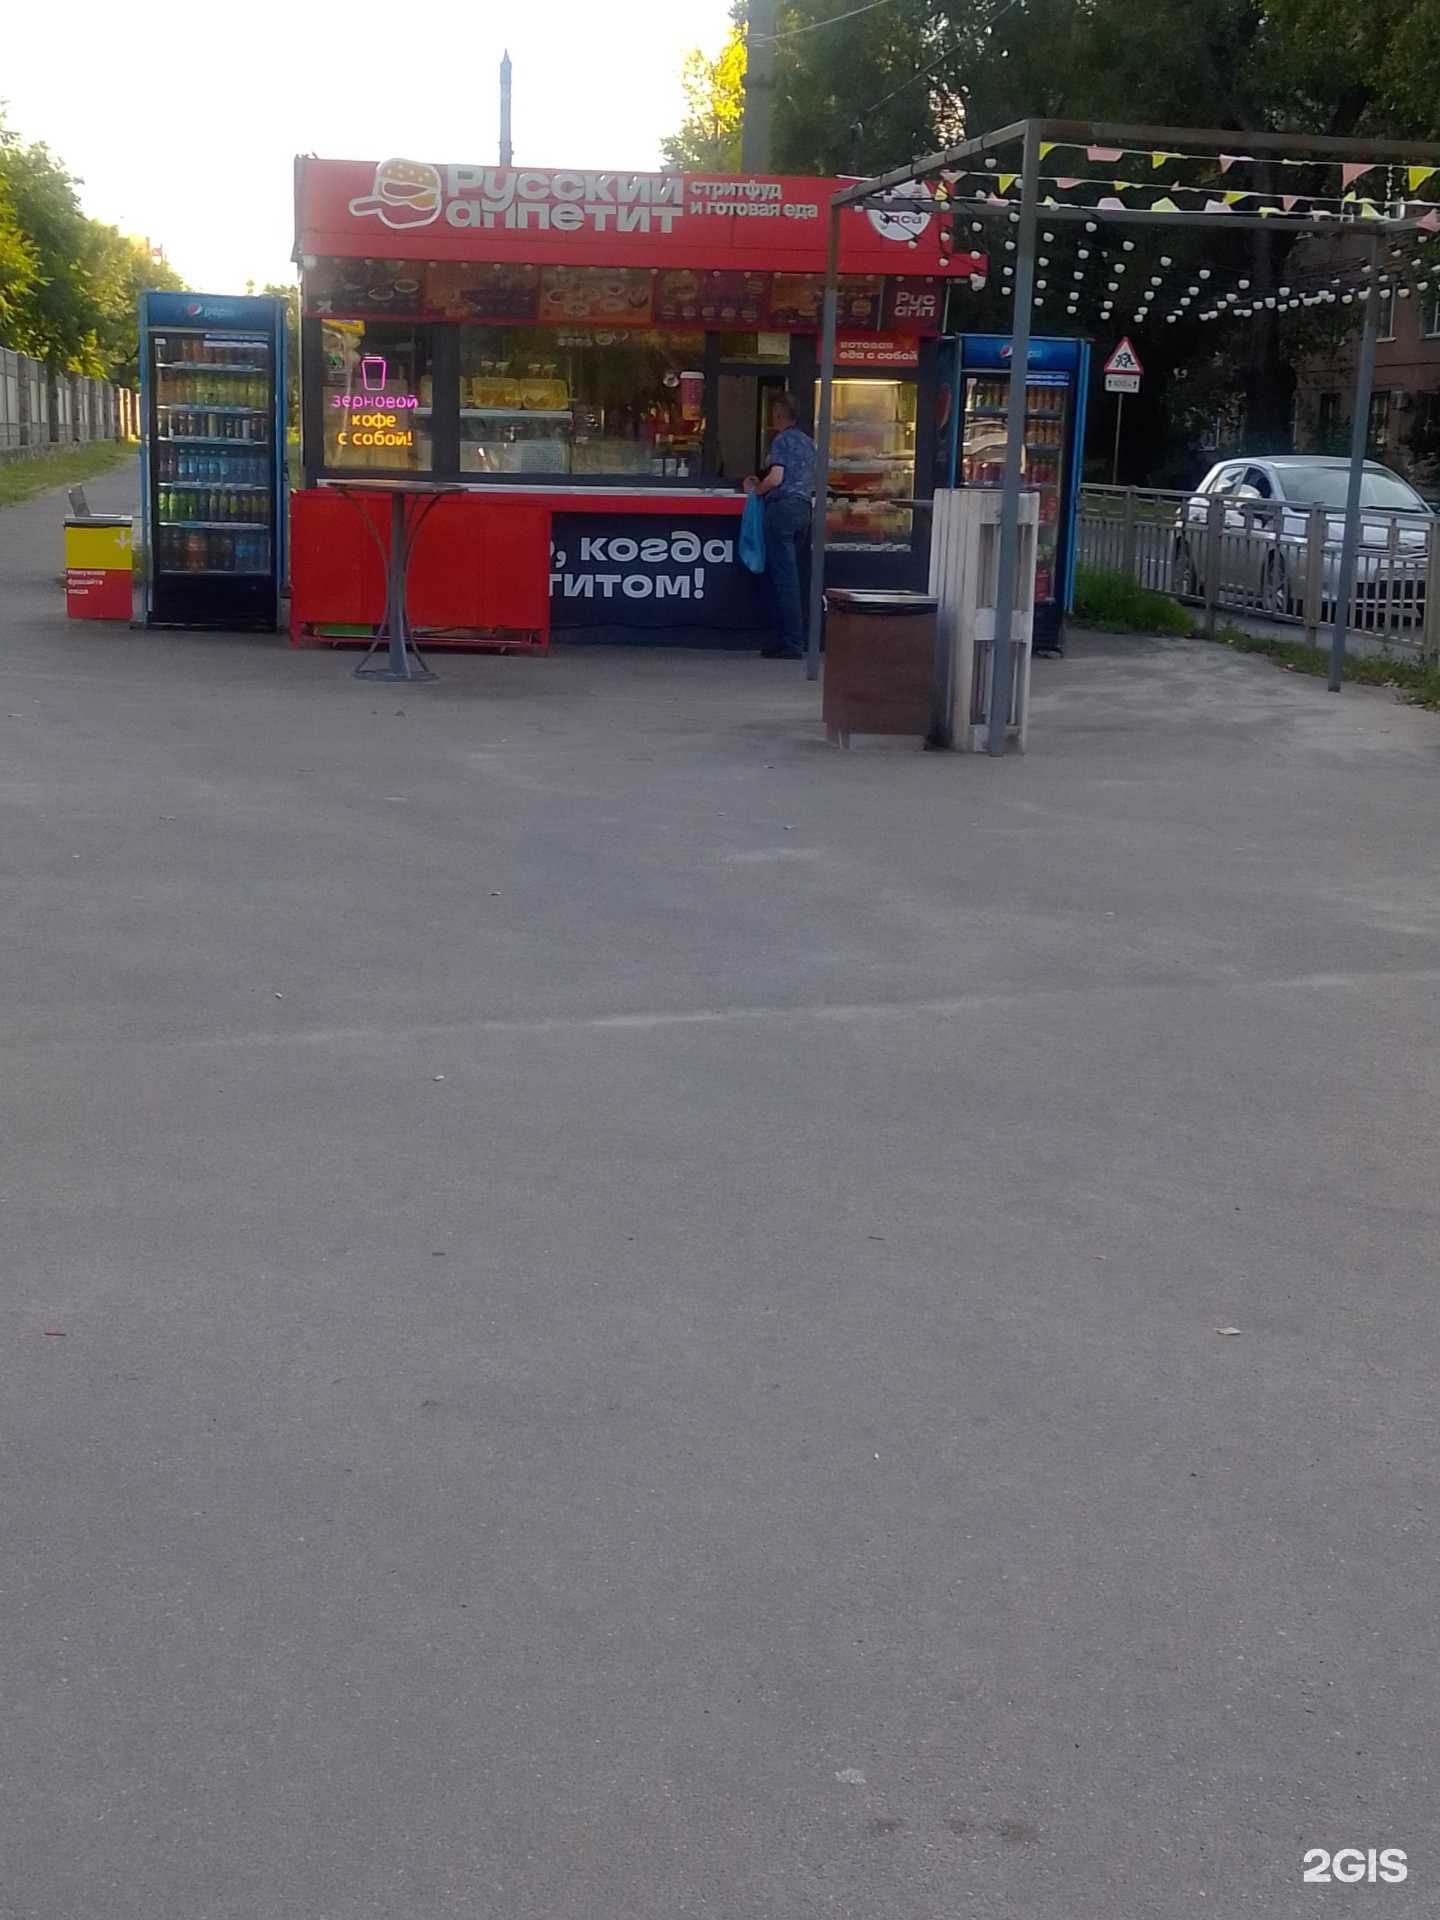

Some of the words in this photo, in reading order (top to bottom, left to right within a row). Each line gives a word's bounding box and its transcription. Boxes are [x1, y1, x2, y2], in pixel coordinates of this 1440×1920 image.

[448, 164, 684, 212] Русский
[690, 180, 783, 201] стритфуд
[446, 200, 684, 233] аппетит
[690, 201, 703, 215] и
[707, 202, 780, 217] готовая
[783, 203, 818, 219] еда
[895, 291, 936, 310] Рус
[866, 351, 876, 359] с
[331, 394, 418, 410] зерновой
[351, 412, 397, 429] кофе
[337, 431, 347, 446] с
[352, 430, 414, 447] собой!
[580, 530, 734, 563] когда
